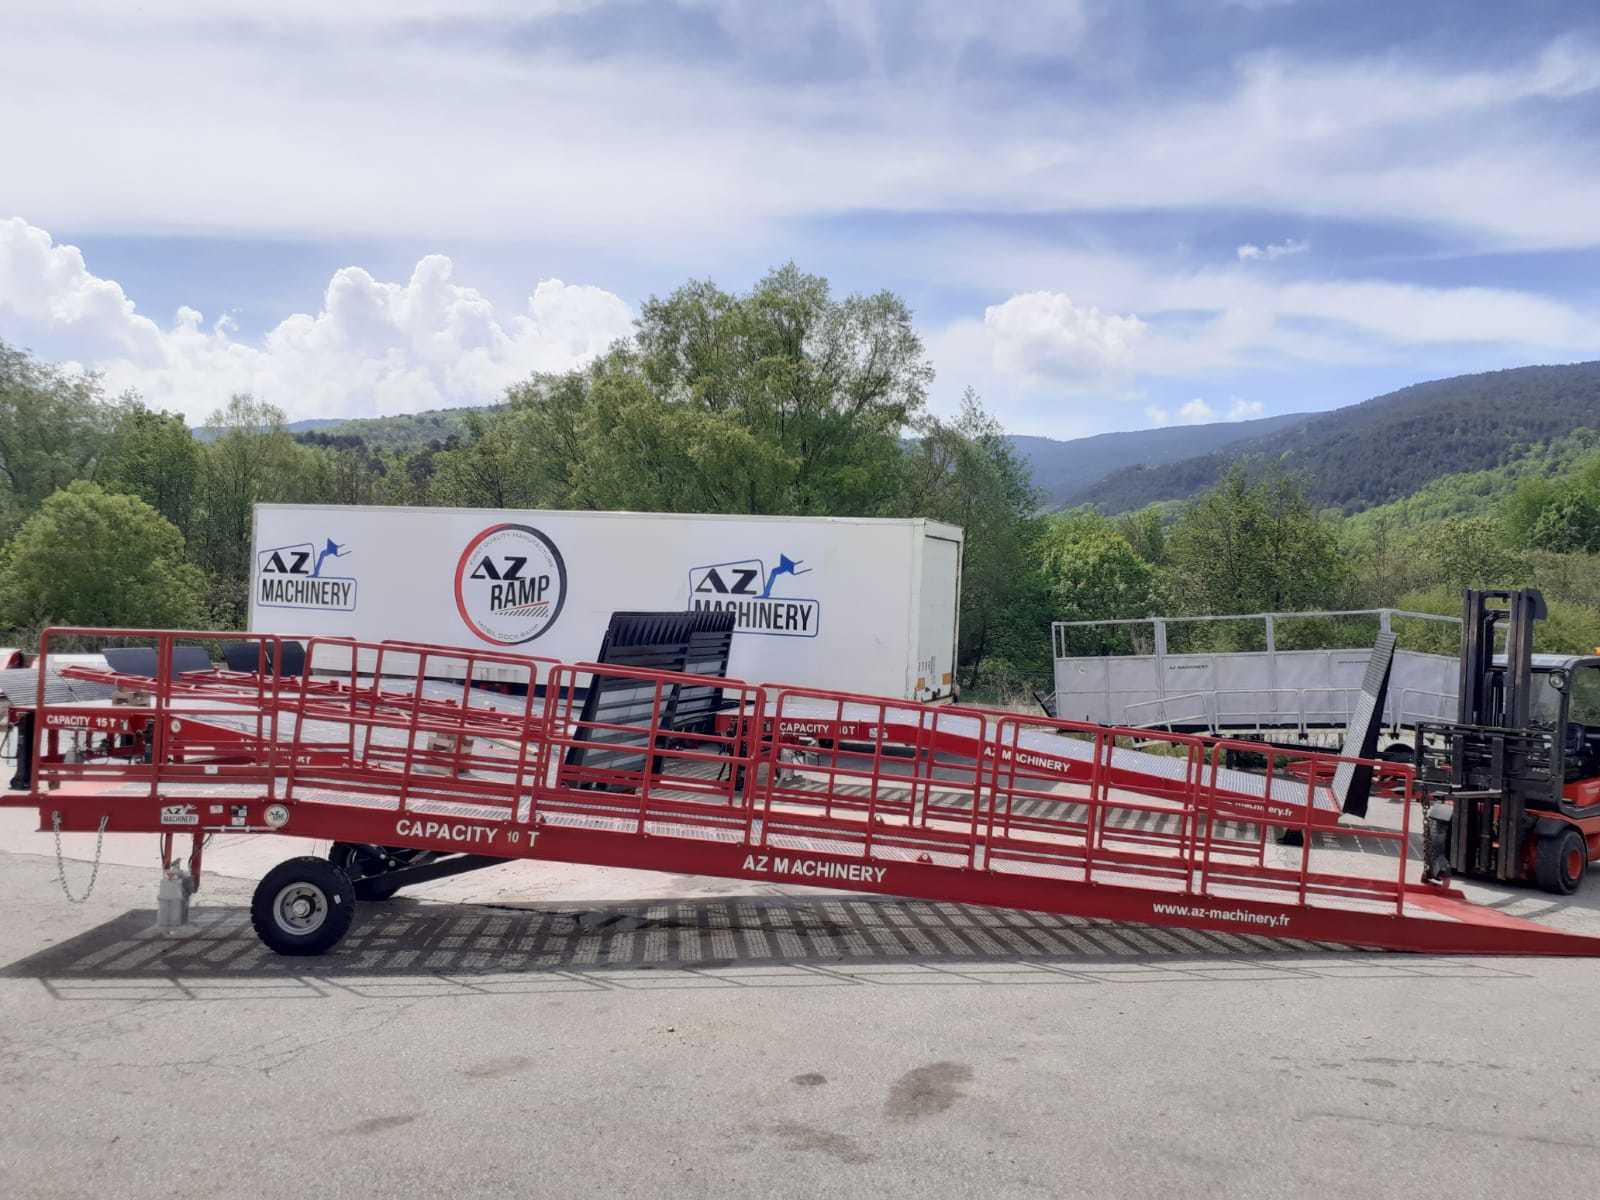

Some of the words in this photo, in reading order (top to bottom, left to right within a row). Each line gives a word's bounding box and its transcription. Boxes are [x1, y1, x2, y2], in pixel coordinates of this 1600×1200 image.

[262, 551, 310, 574] AZ
[470, 555, 527, 581] AZ
[261, 578, 352, 606] MACHINERY
[490, 574, 550, 611] RAMP
[694, 568, 757, 595] AZ
[47, 715, 90, 726] CAPACITY
[779, 722, 829, 734] CAPACITY
[396, 819, 498, 844] CAPACITY
[506, 831, 520, 843] 10
[527, 831, 540, 848] T
[742, 854, 769, 872] AZ
[773, 857, 887, 883] MACHINERY
[1152, 903, 1290, 927] www.az-machinery.fr
